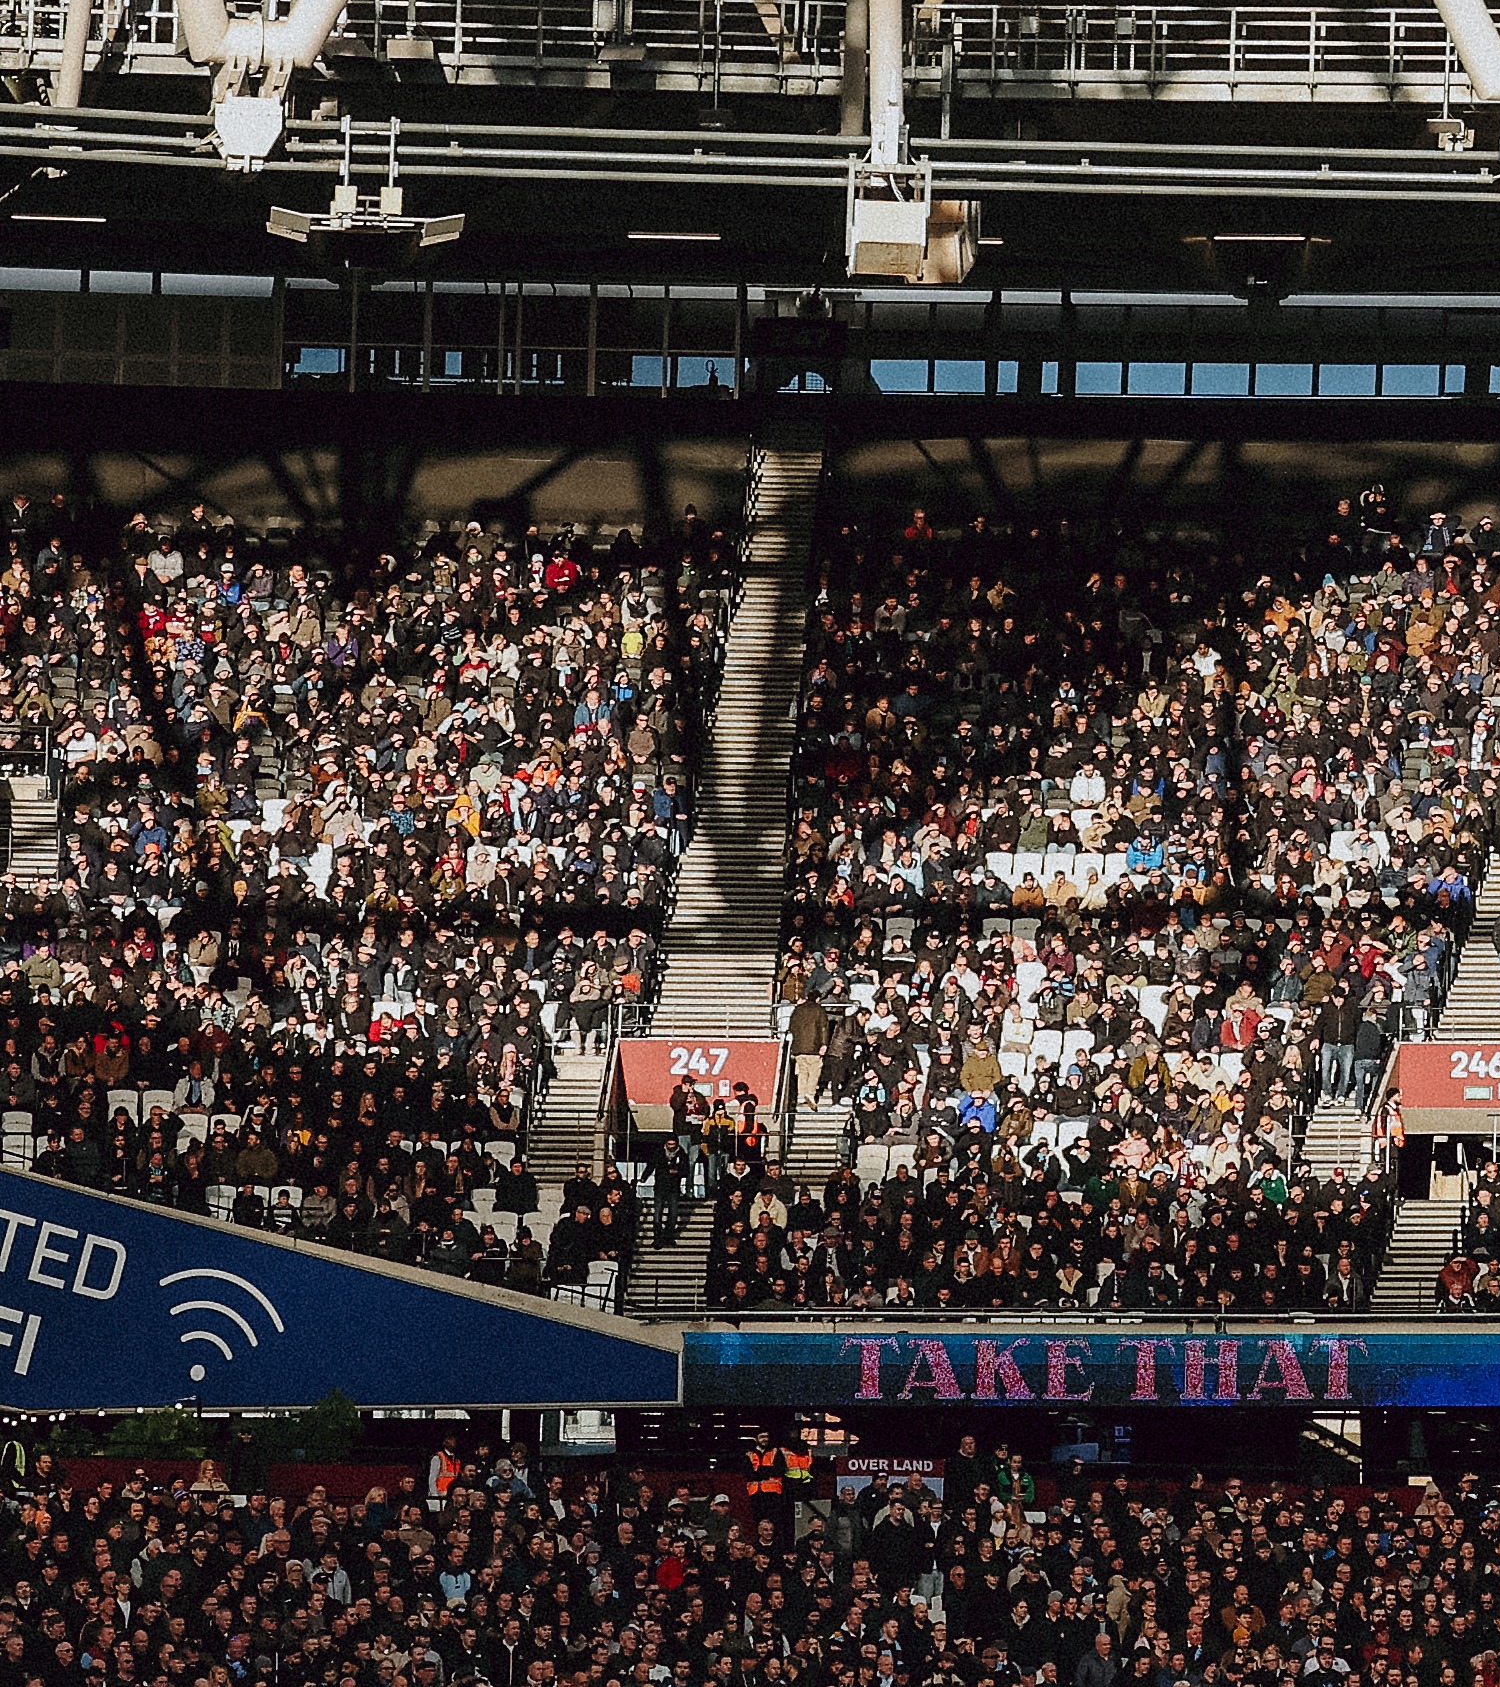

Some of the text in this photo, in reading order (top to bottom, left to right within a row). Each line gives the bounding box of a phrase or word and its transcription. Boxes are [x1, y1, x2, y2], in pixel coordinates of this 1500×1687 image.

[670, 1047, 729, 1075] 247
[840, 1338, 1369, 1400] TAKE THAT
[848, 1459, 933, 1472] OVER LAND
